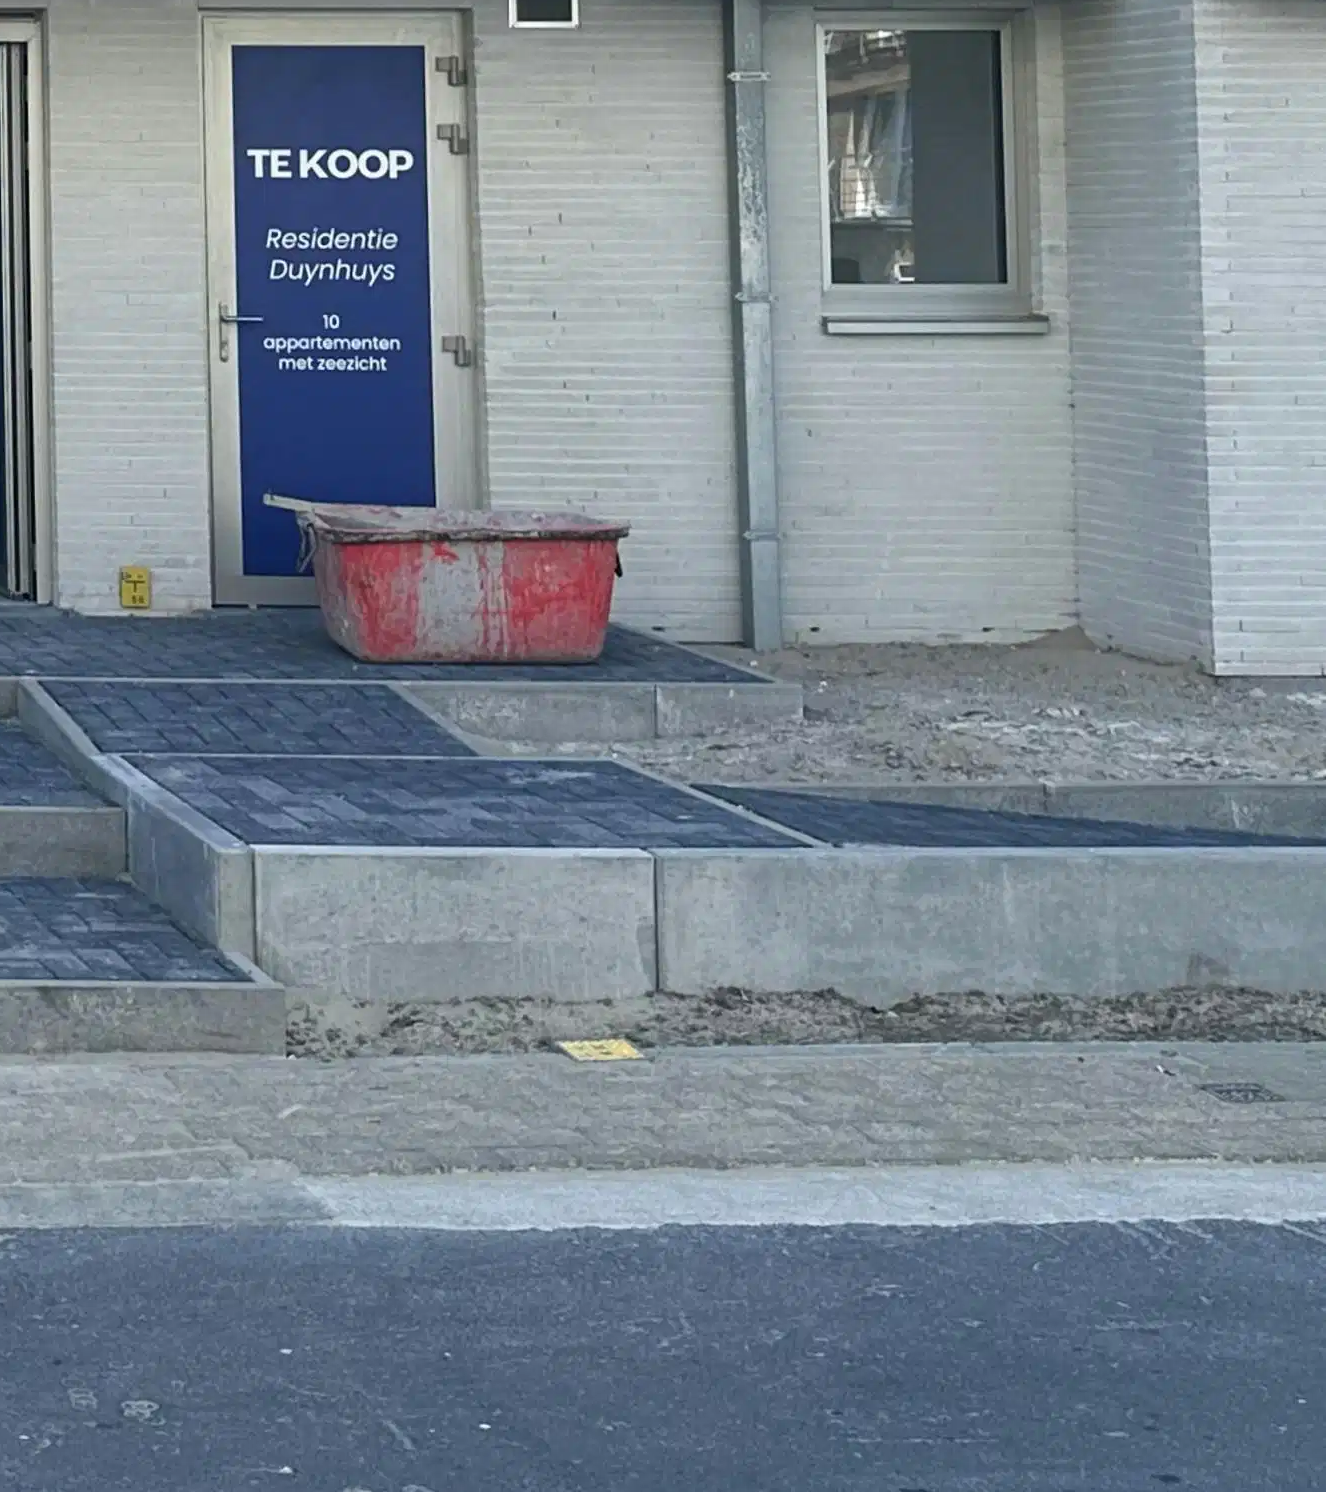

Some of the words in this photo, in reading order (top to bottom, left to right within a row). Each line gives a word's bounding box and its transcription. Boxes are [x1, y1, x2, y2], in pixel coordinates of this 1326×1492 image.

[247, 149, 292, 178] TE
[300, 149, 414, 179] KOOP
[265, 227, 399, 250] Residentie
[269, 258, 396, 286] Duynhuys
[322, 314, 340, 330] 10
[263, 335, 401, 353] appartementen
[278, 356, 314, 371] met
[317, 355, 387, 372] zeezicht
